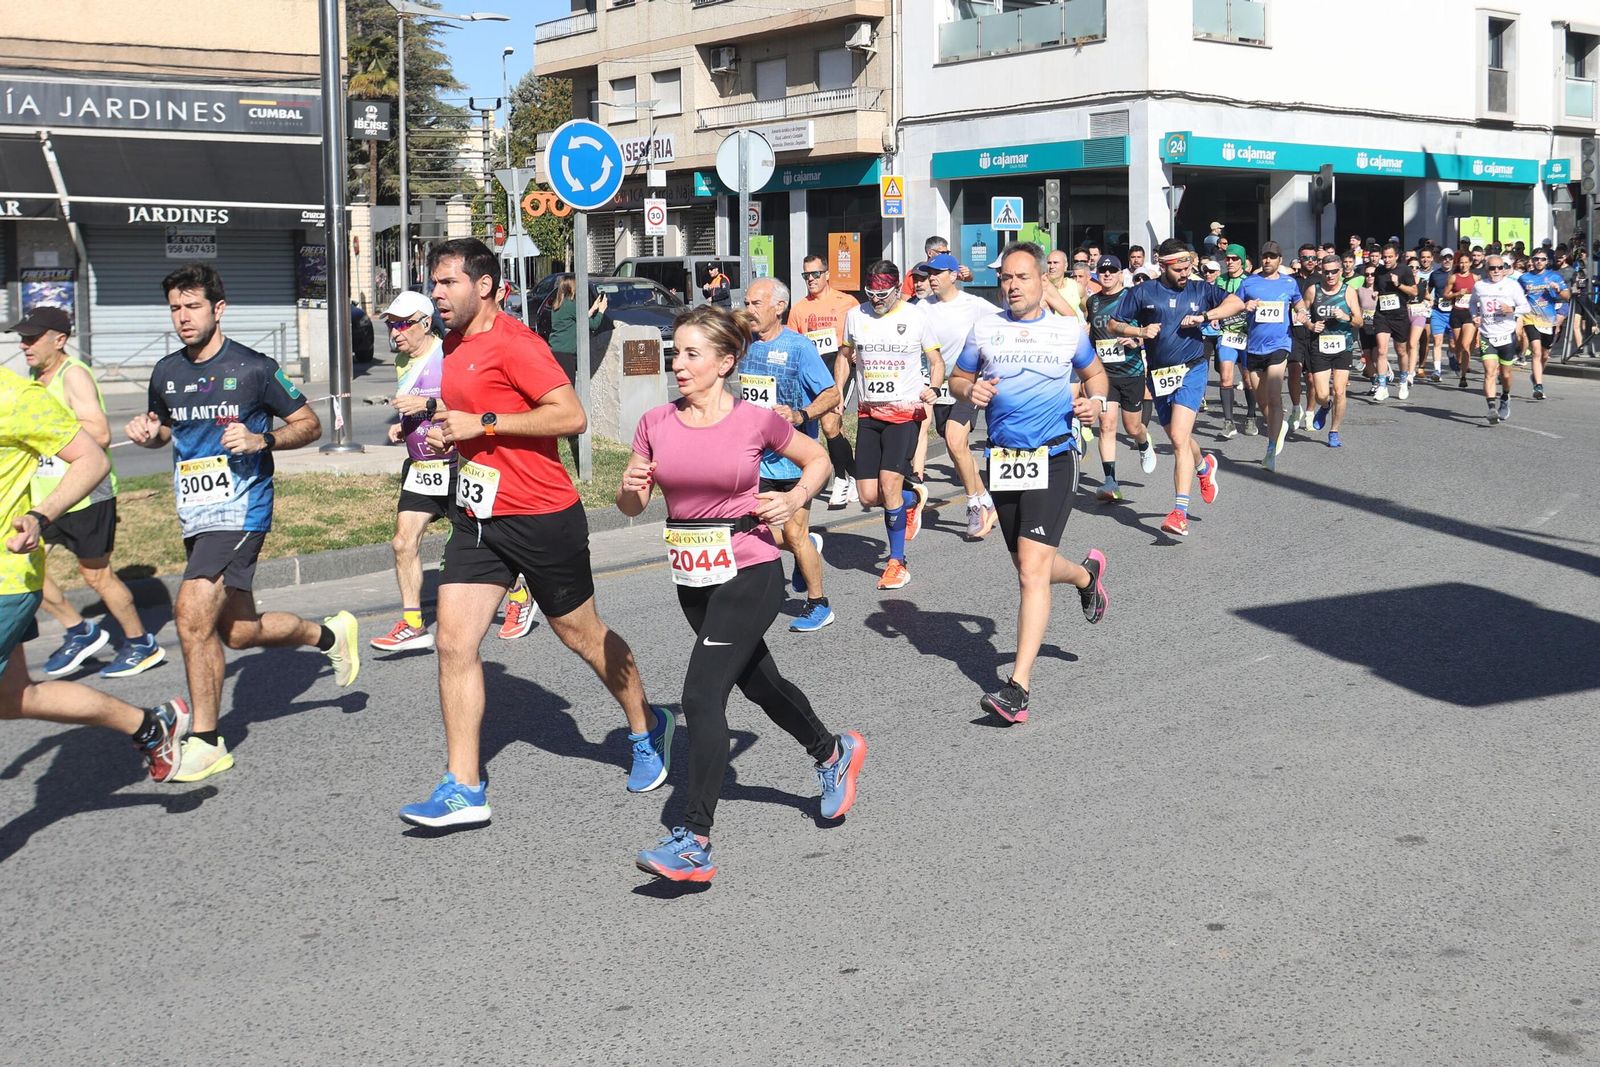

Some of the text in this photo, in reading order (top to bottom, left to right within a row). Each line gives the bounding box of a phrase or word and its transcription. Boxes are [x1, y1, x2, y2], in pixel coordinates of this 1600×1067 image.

[59, 96, 227, 123] JARDINES
[248, 107, 304, 120] CUMBAL
[620, 138, 673, 163] SESRIA
[1170, 140, 1184, 153] 24
[1237, 145, 1277, 162] cajamar
[992, 151, 1029, 169] cajamar
[1369, 154, 1404, 171] cajamar
[1484, 161, 1515, 177] cajamar
[793, 171, 821, 184] cajamar
[128, 206, 229, 224] JARDINES
[651, 212, 661, 220] 30
[1260, 309, 1280, 317] 470
[1323, 341, 1341, 350] 341
[992, 354, 1061, 365] MARACENA
[742, 387, 769, 402] 594
[867, 381, 895, 394] 428
[168, 401, 239, 421] AN ANTÓN
[999, 462, 1039, 480] 203
[181, 472, 230, 495] 3004
[415, 472, 443, 487] 568
[669, 548, 732, 572] 2044
